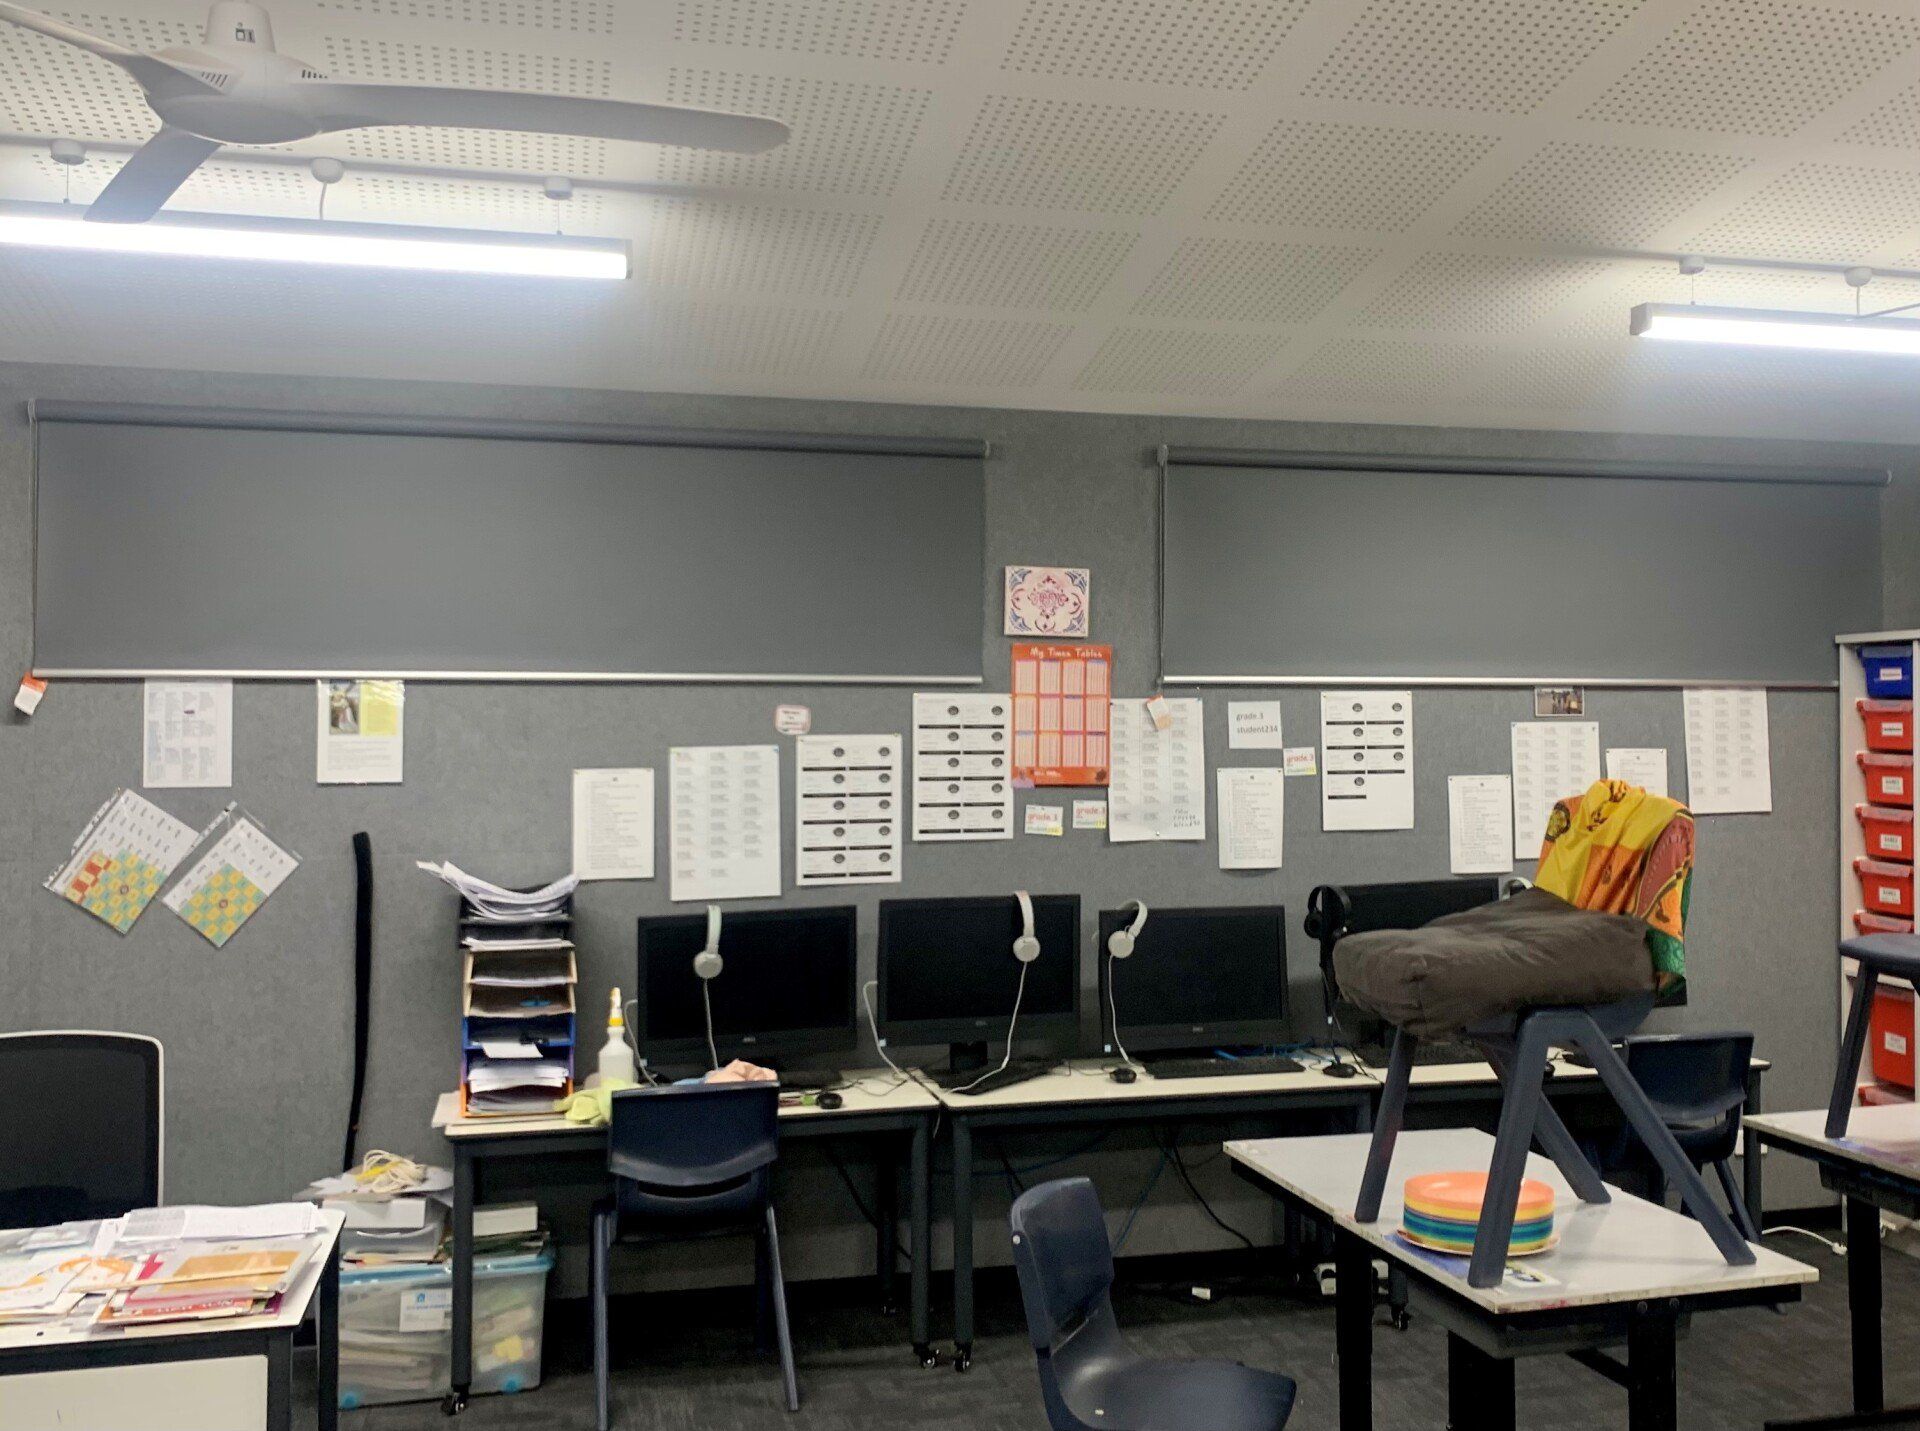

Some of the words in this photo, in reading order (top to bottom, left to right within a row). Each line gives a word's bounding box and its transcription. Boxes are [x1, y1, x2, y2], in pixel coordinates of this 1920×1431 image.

[1030, 647, 1044, 659] My
[1047, 647, 1071, 658] Times
[1075, 648, 1103, 658] Tables
